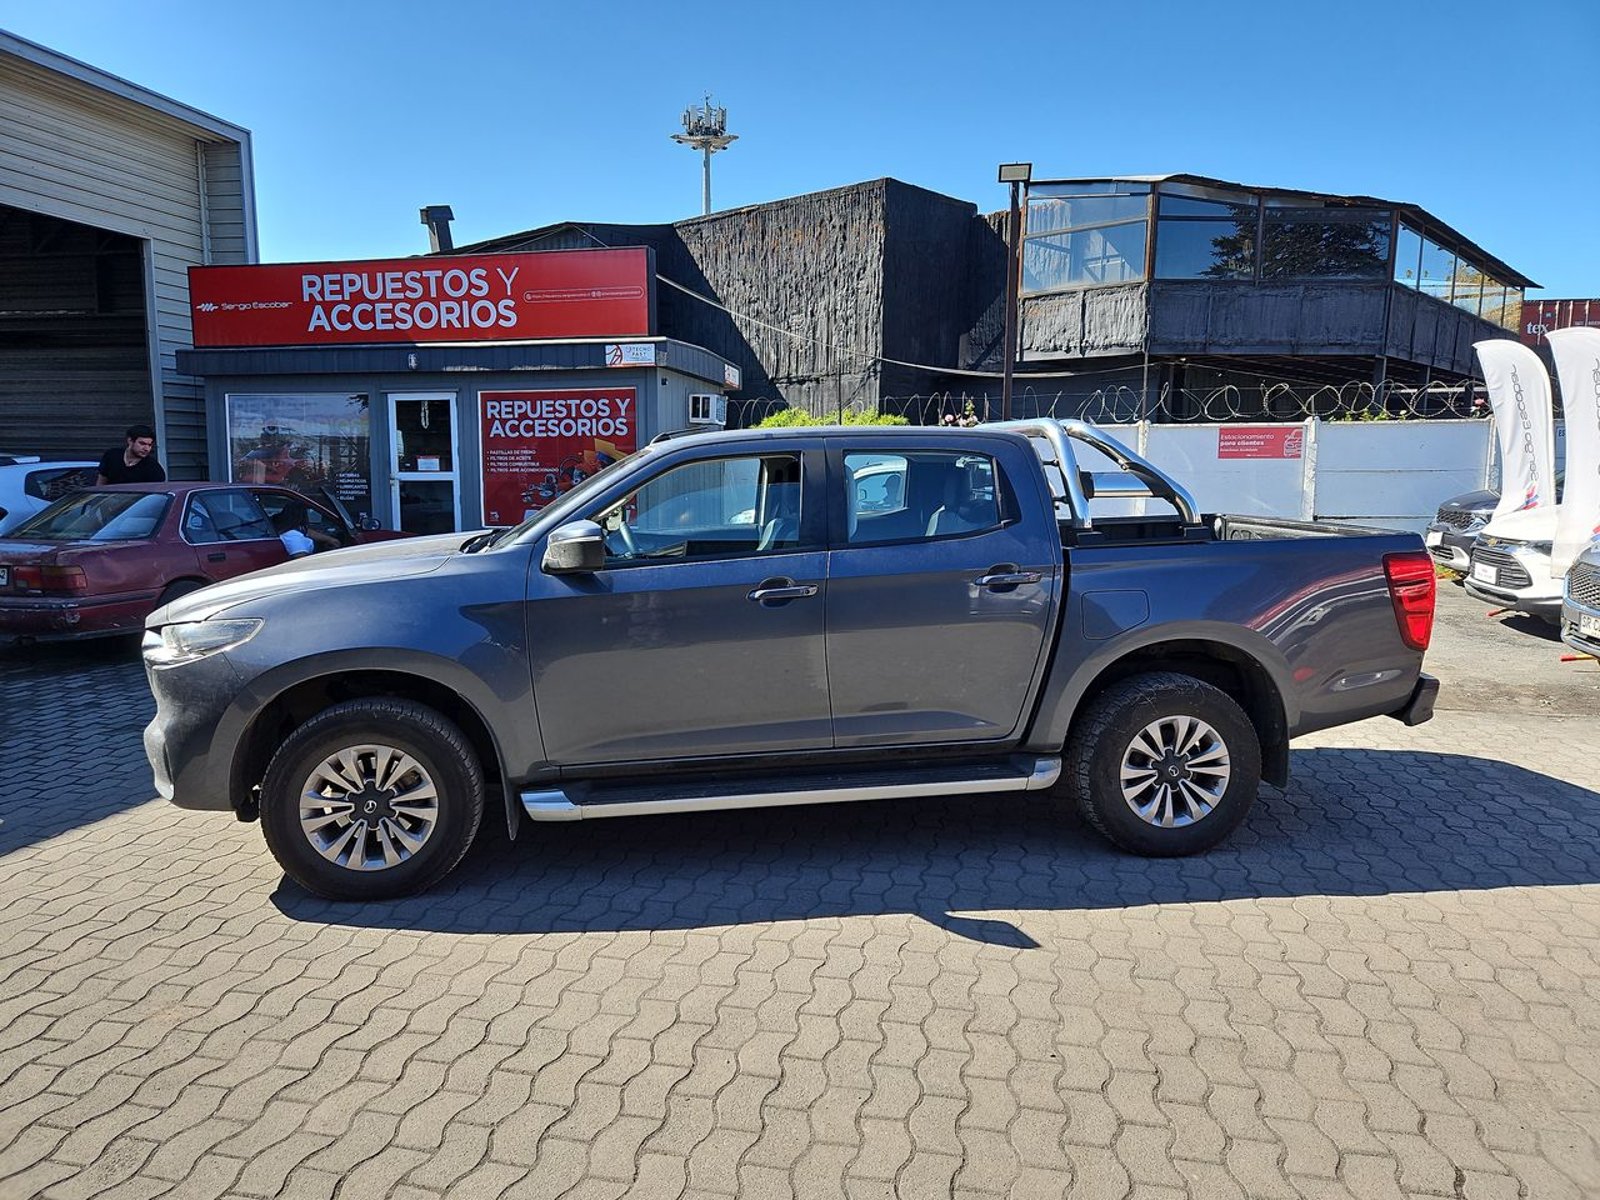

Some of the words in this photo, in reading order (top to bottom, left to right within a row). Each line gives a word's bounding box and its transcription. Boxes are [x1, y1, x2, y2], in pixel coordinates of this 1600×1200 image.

[302, 268, 490, 302] REPUESTOS
[496, 266, 519, 295] Y
[307, 299, 518, 332] ACCESORIOS
[1526, 321, 1549, 335] tex
[486, 399, 611, 419] REPUESTOS
[615, 398, 631, 416] Y
[489, 418, 628, 437] ACCESORIOS
